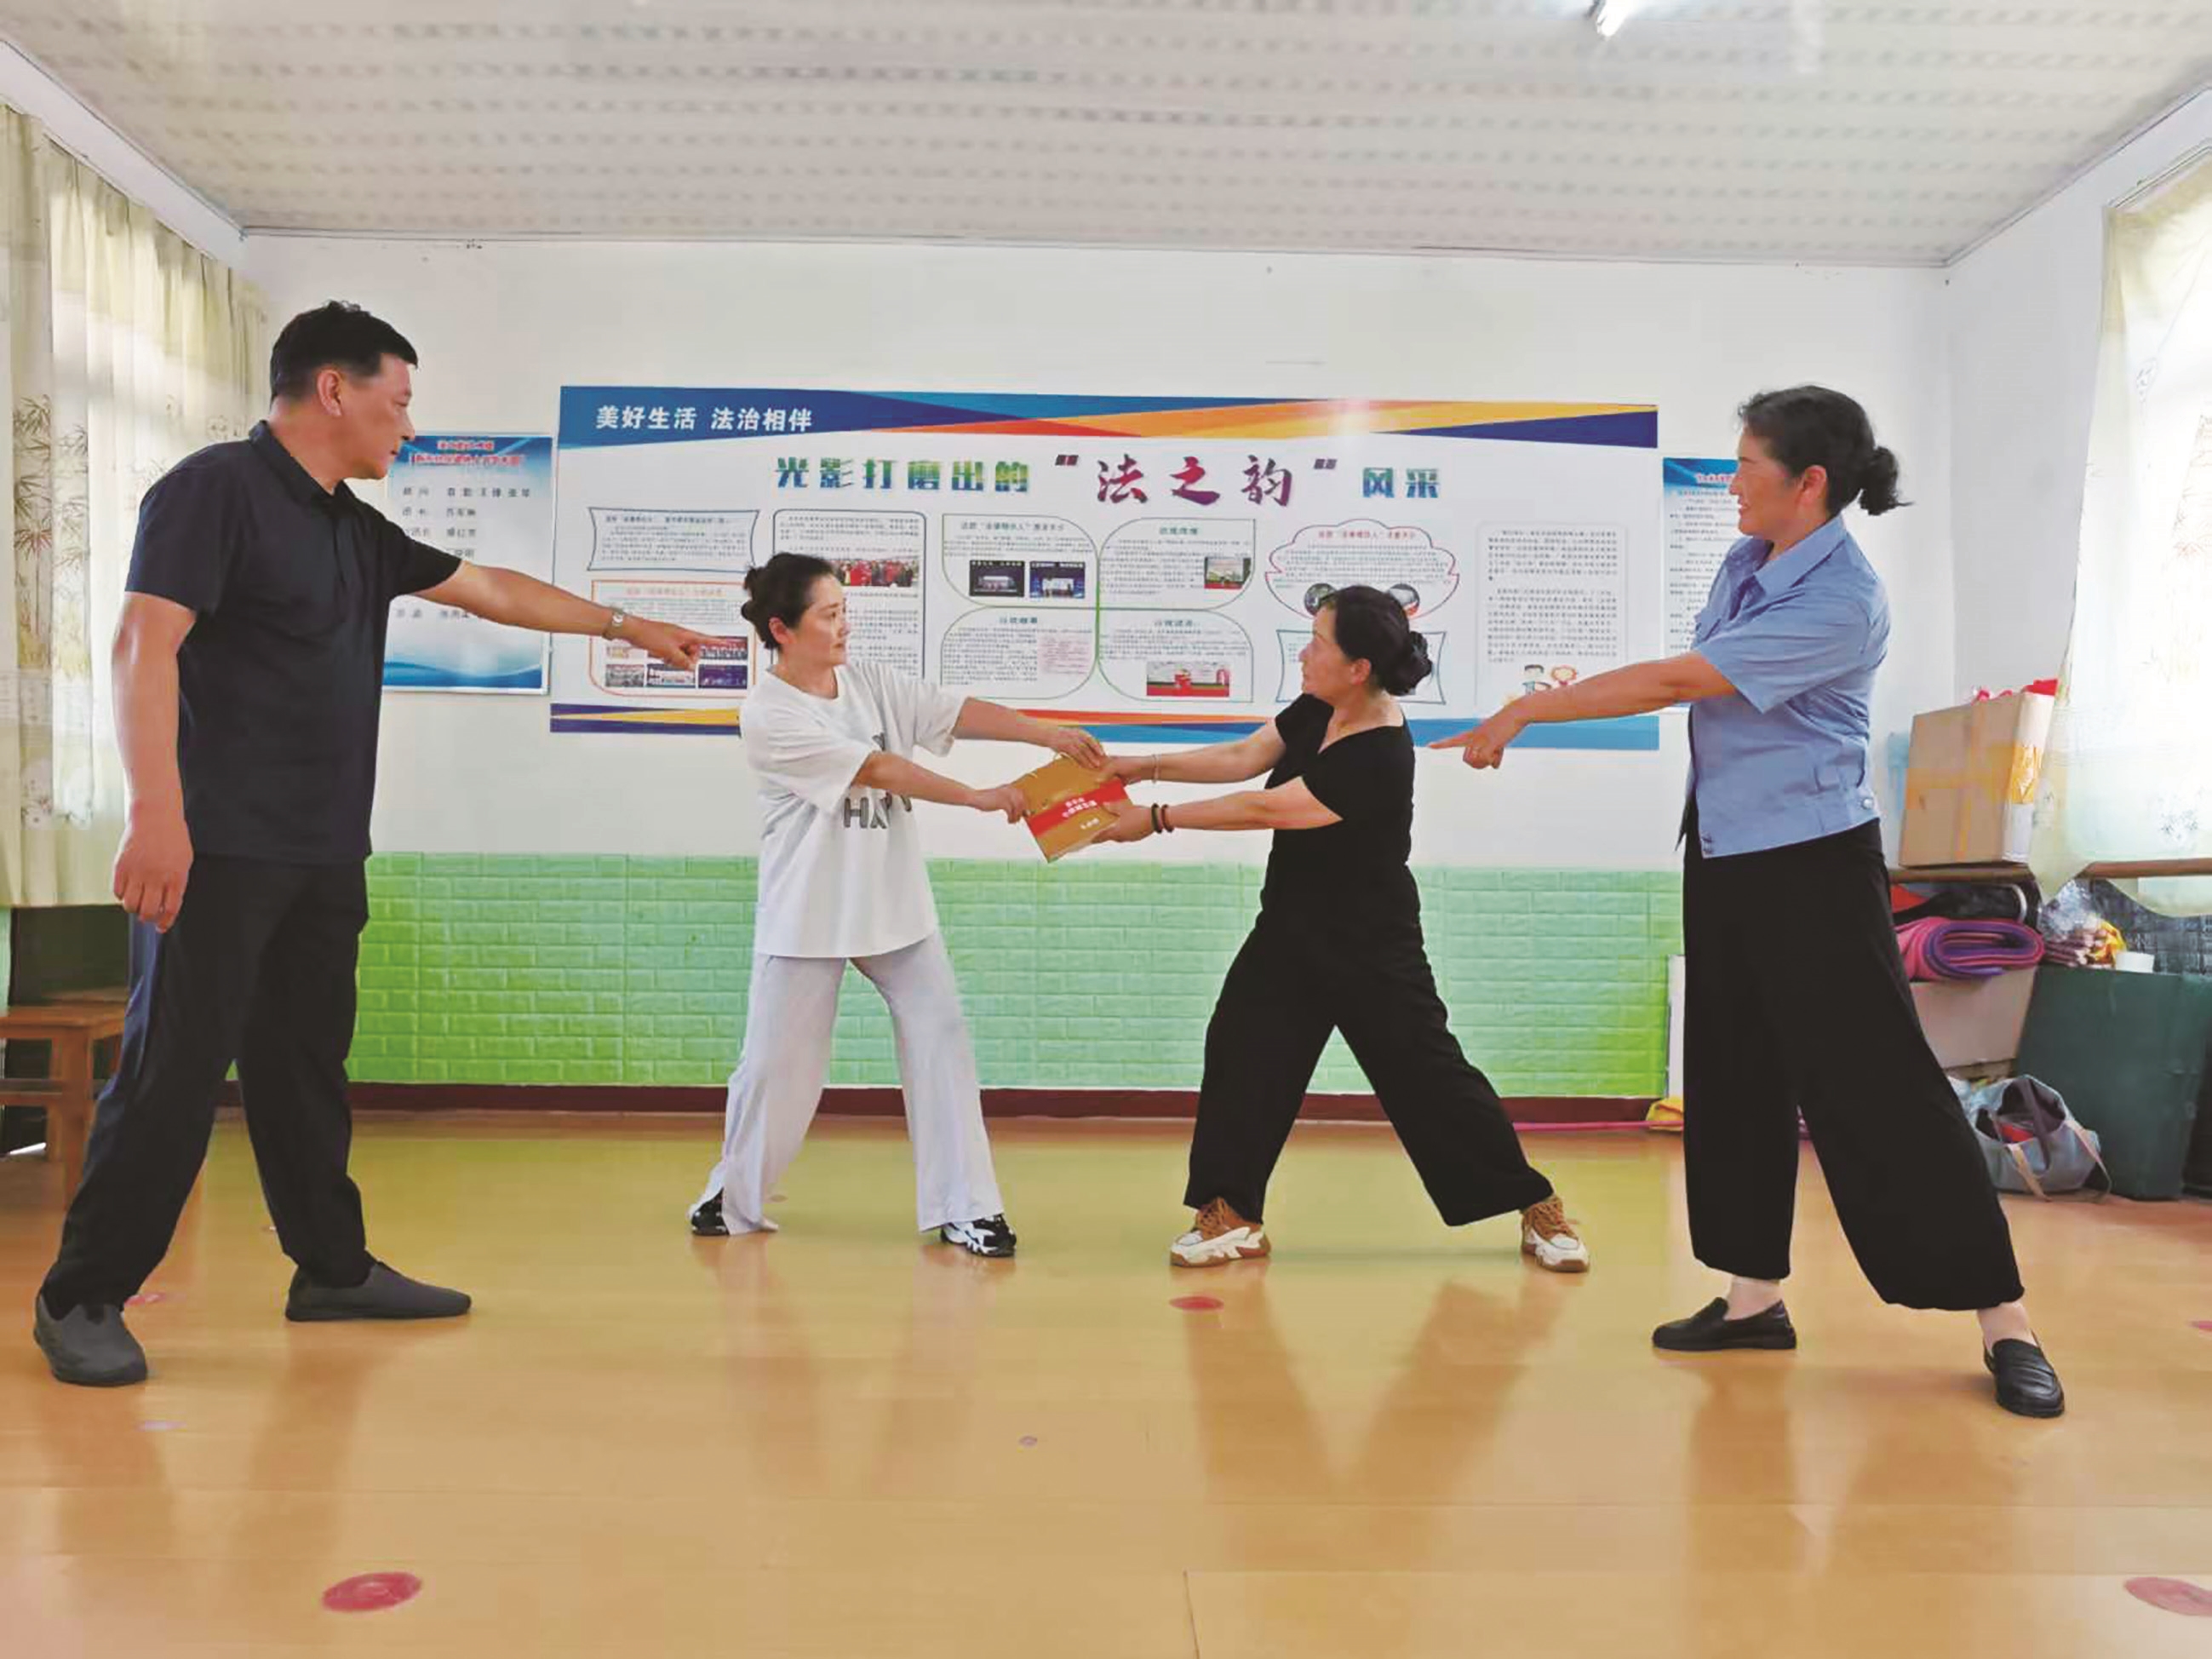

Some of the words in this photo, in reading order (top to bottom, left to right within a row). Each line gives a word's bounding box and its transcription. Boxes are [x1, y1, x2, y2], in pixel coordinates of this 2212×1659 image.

[597, 405, 696, 430] 美好生活
[711, 408, 811, 432] 法治相伴
